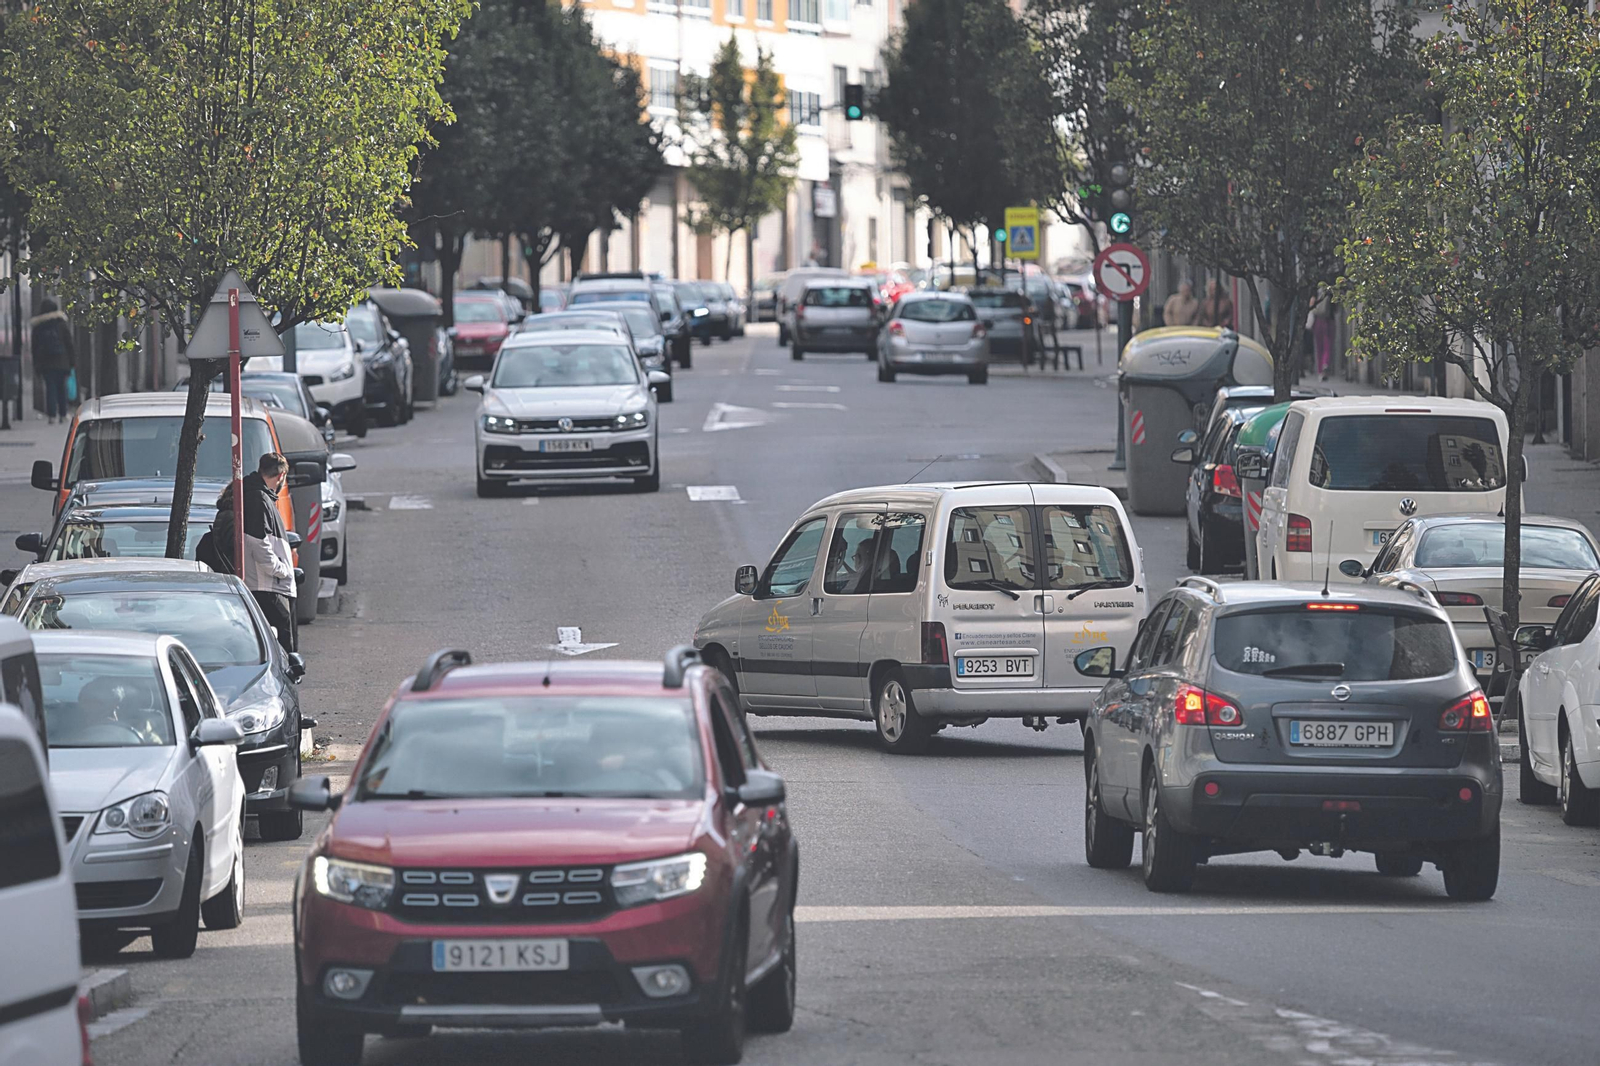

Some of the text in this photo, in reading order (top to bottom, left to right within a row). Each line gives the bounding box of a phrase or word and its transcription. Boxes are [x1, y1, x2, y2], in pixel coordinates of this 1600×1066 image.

[966, 659, 1029, 673] 9253 BVT
[1214, 732, 1255, 741] QASHQAI
[1303, 724, 1388, 742] 6887 GPH
[450, 944, 562, 967] 9121 KSJ
